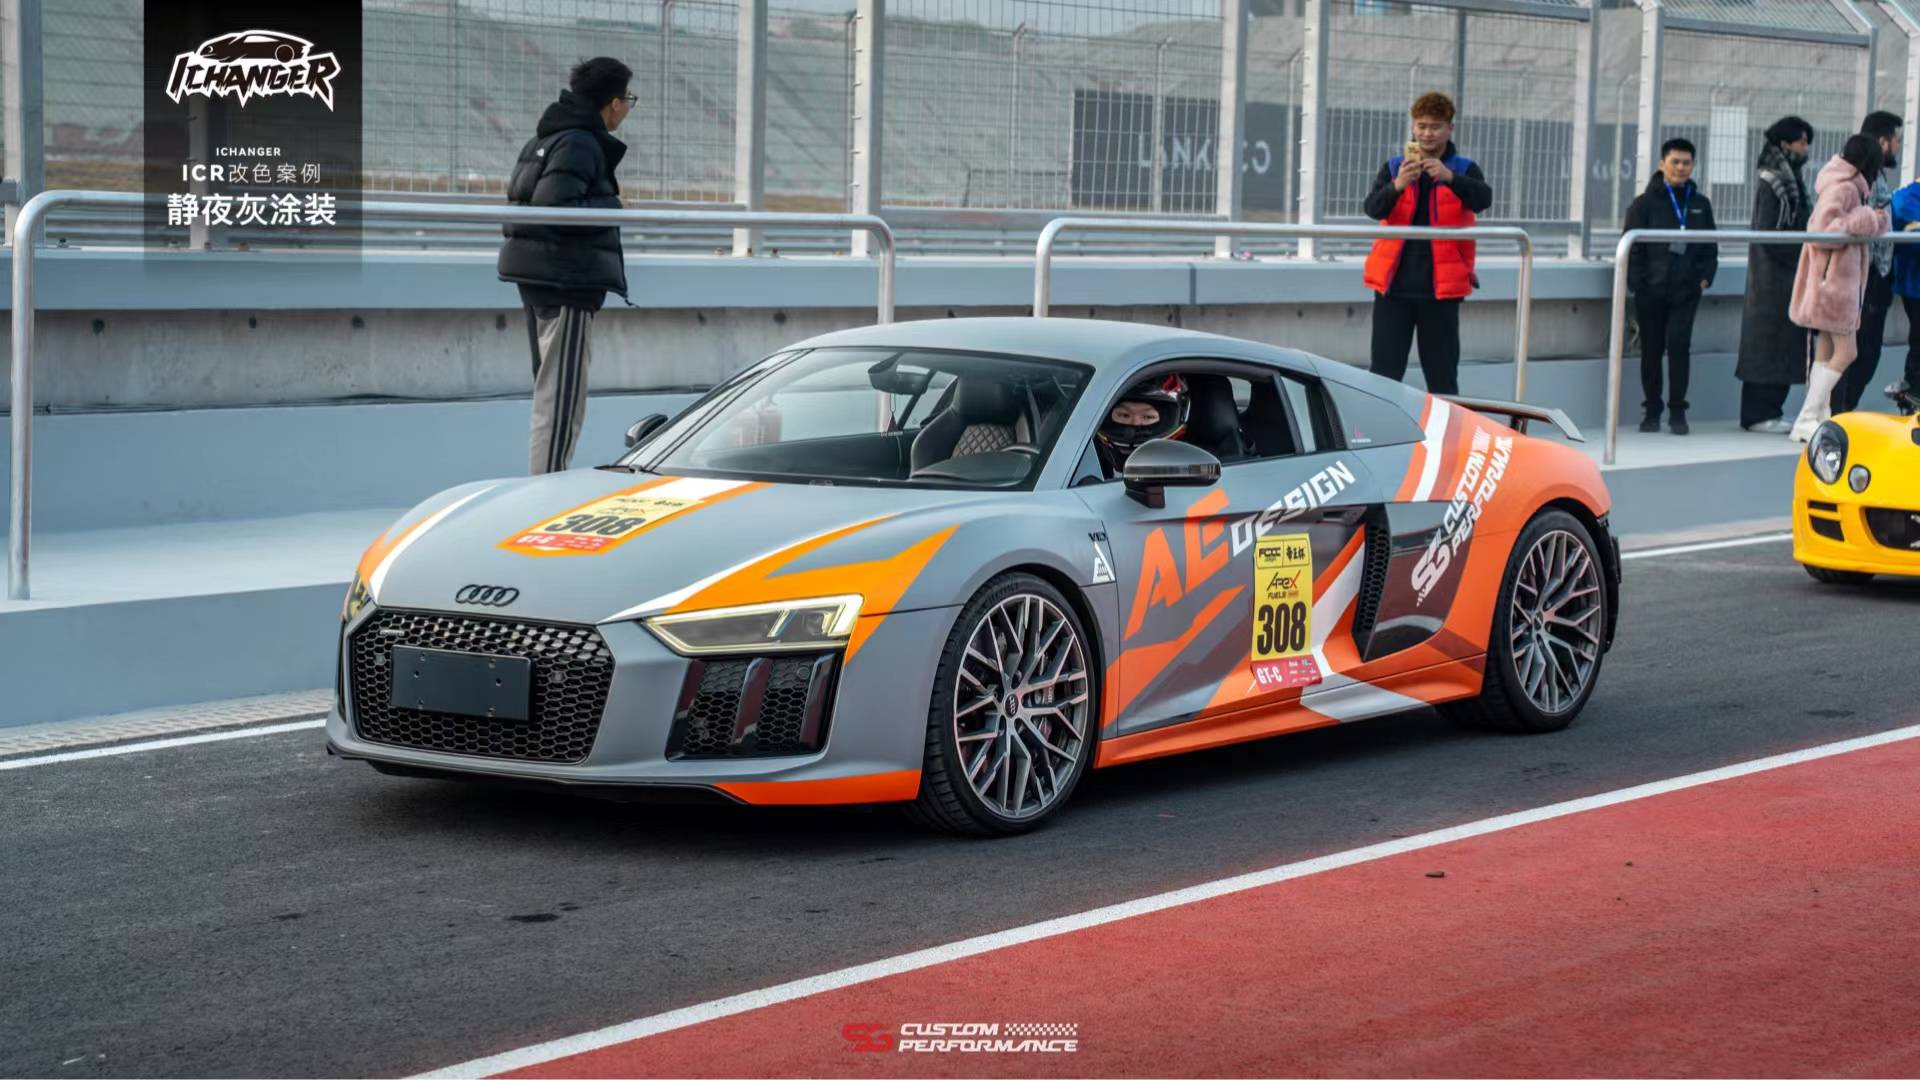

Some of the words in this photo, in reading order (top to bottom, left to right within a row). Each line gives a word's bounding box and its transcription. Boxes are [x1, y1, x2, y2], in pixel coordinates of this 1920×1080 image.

[544, 514, 647, 536] 308
[1230, 460, 1356, 557] DESIGN
[1443, 450, 1490, 535] CUSTOM
[1123, 487, 1231, 641] AE
[1256, 601, 1307, 656] 308
[1256, 665, 1283, 685] GT-C
